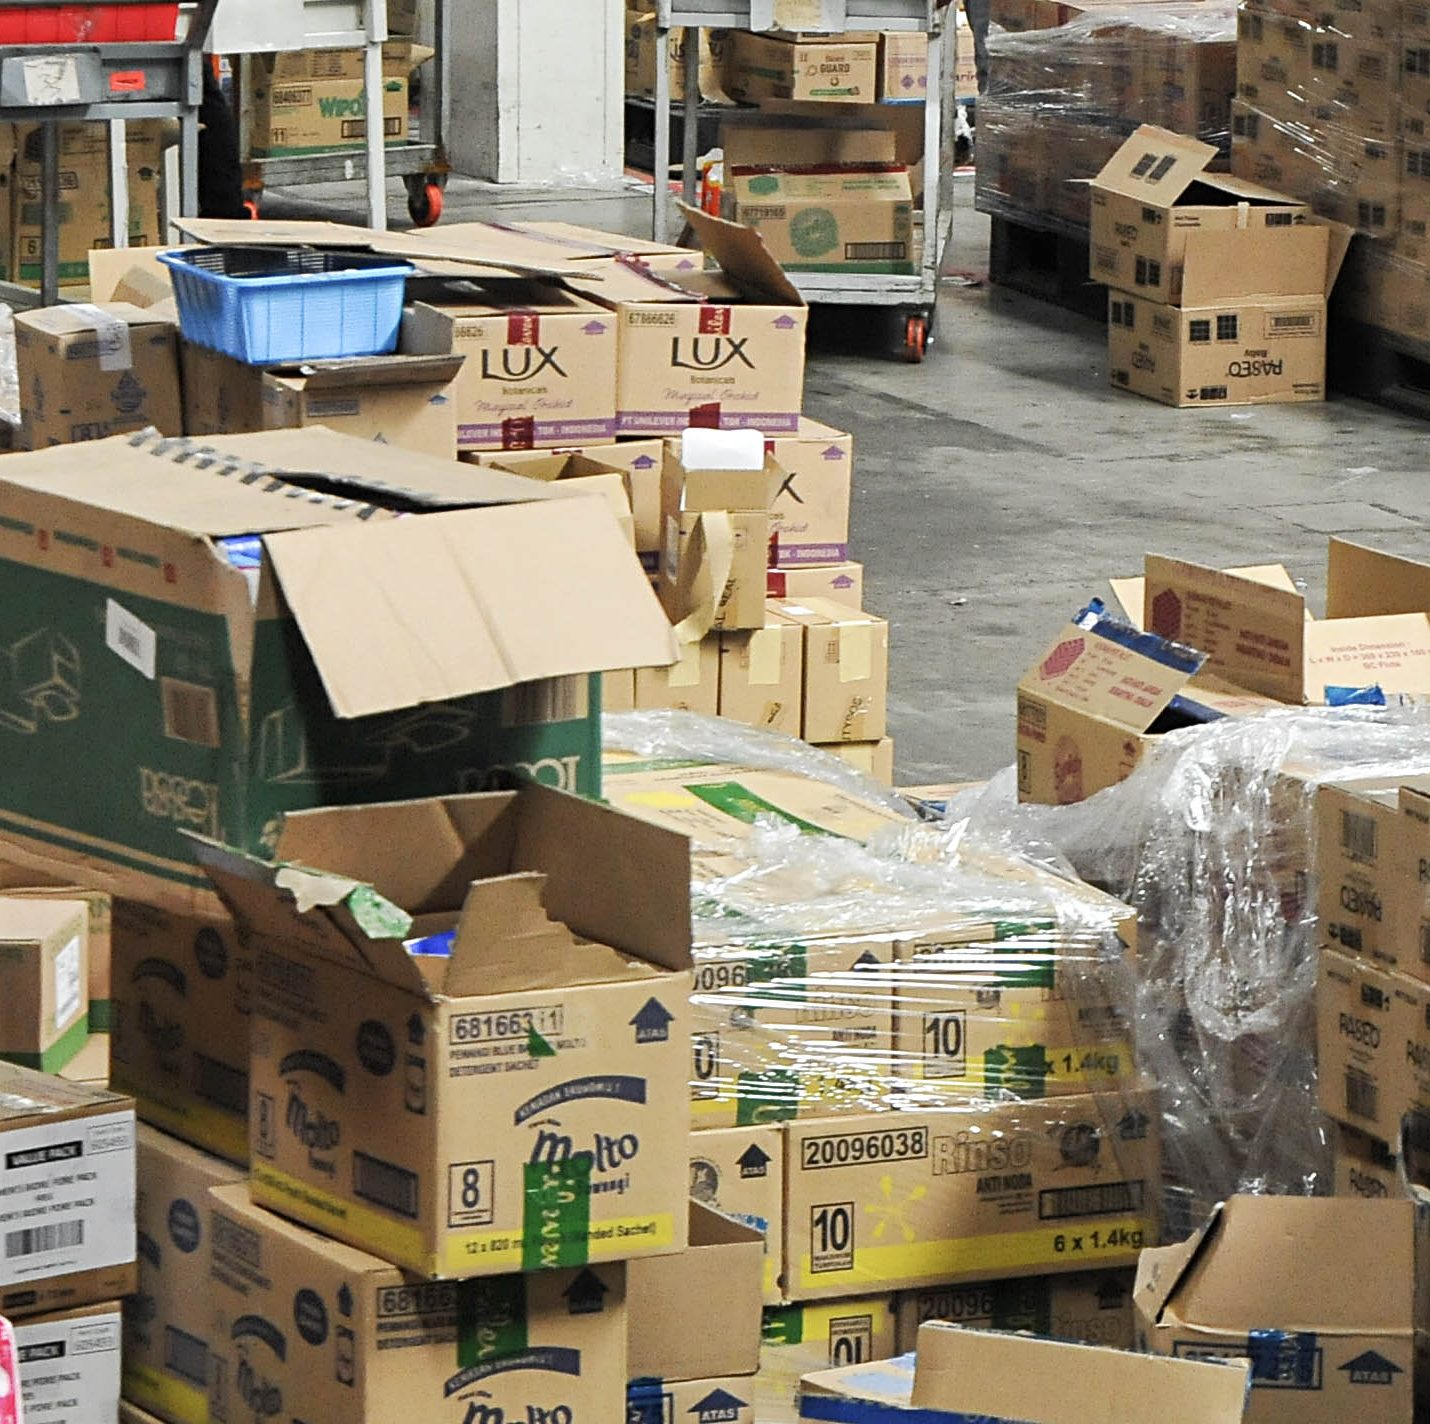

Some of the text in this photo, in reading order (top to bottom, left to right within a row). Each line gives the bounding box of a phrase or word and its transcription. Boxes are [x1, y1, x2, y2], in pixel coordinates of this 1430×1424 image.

[819, 62, 851, 75] GUARD
[318, 91, 368, 120] WIPO
[482, 346, 568, 381] LUX
[671, 337, 756, 372] LUX
[1228, 358, 1283, 377] PASEO
[925, 1014, 963, 1060] 10
[804, 1128, 926, 1167] 20096038
[931, 1132, 1033, 1176] Rinso
[461, 1167, 481, 1209] 8
[976, 1177, 1002, 1195] ANTI
[813, 1207, 850, 1253] 10
[1053, 1228, 1145, 1252] 6 x 1.4kg
[701, 1407, 737, 1422] ATAS
